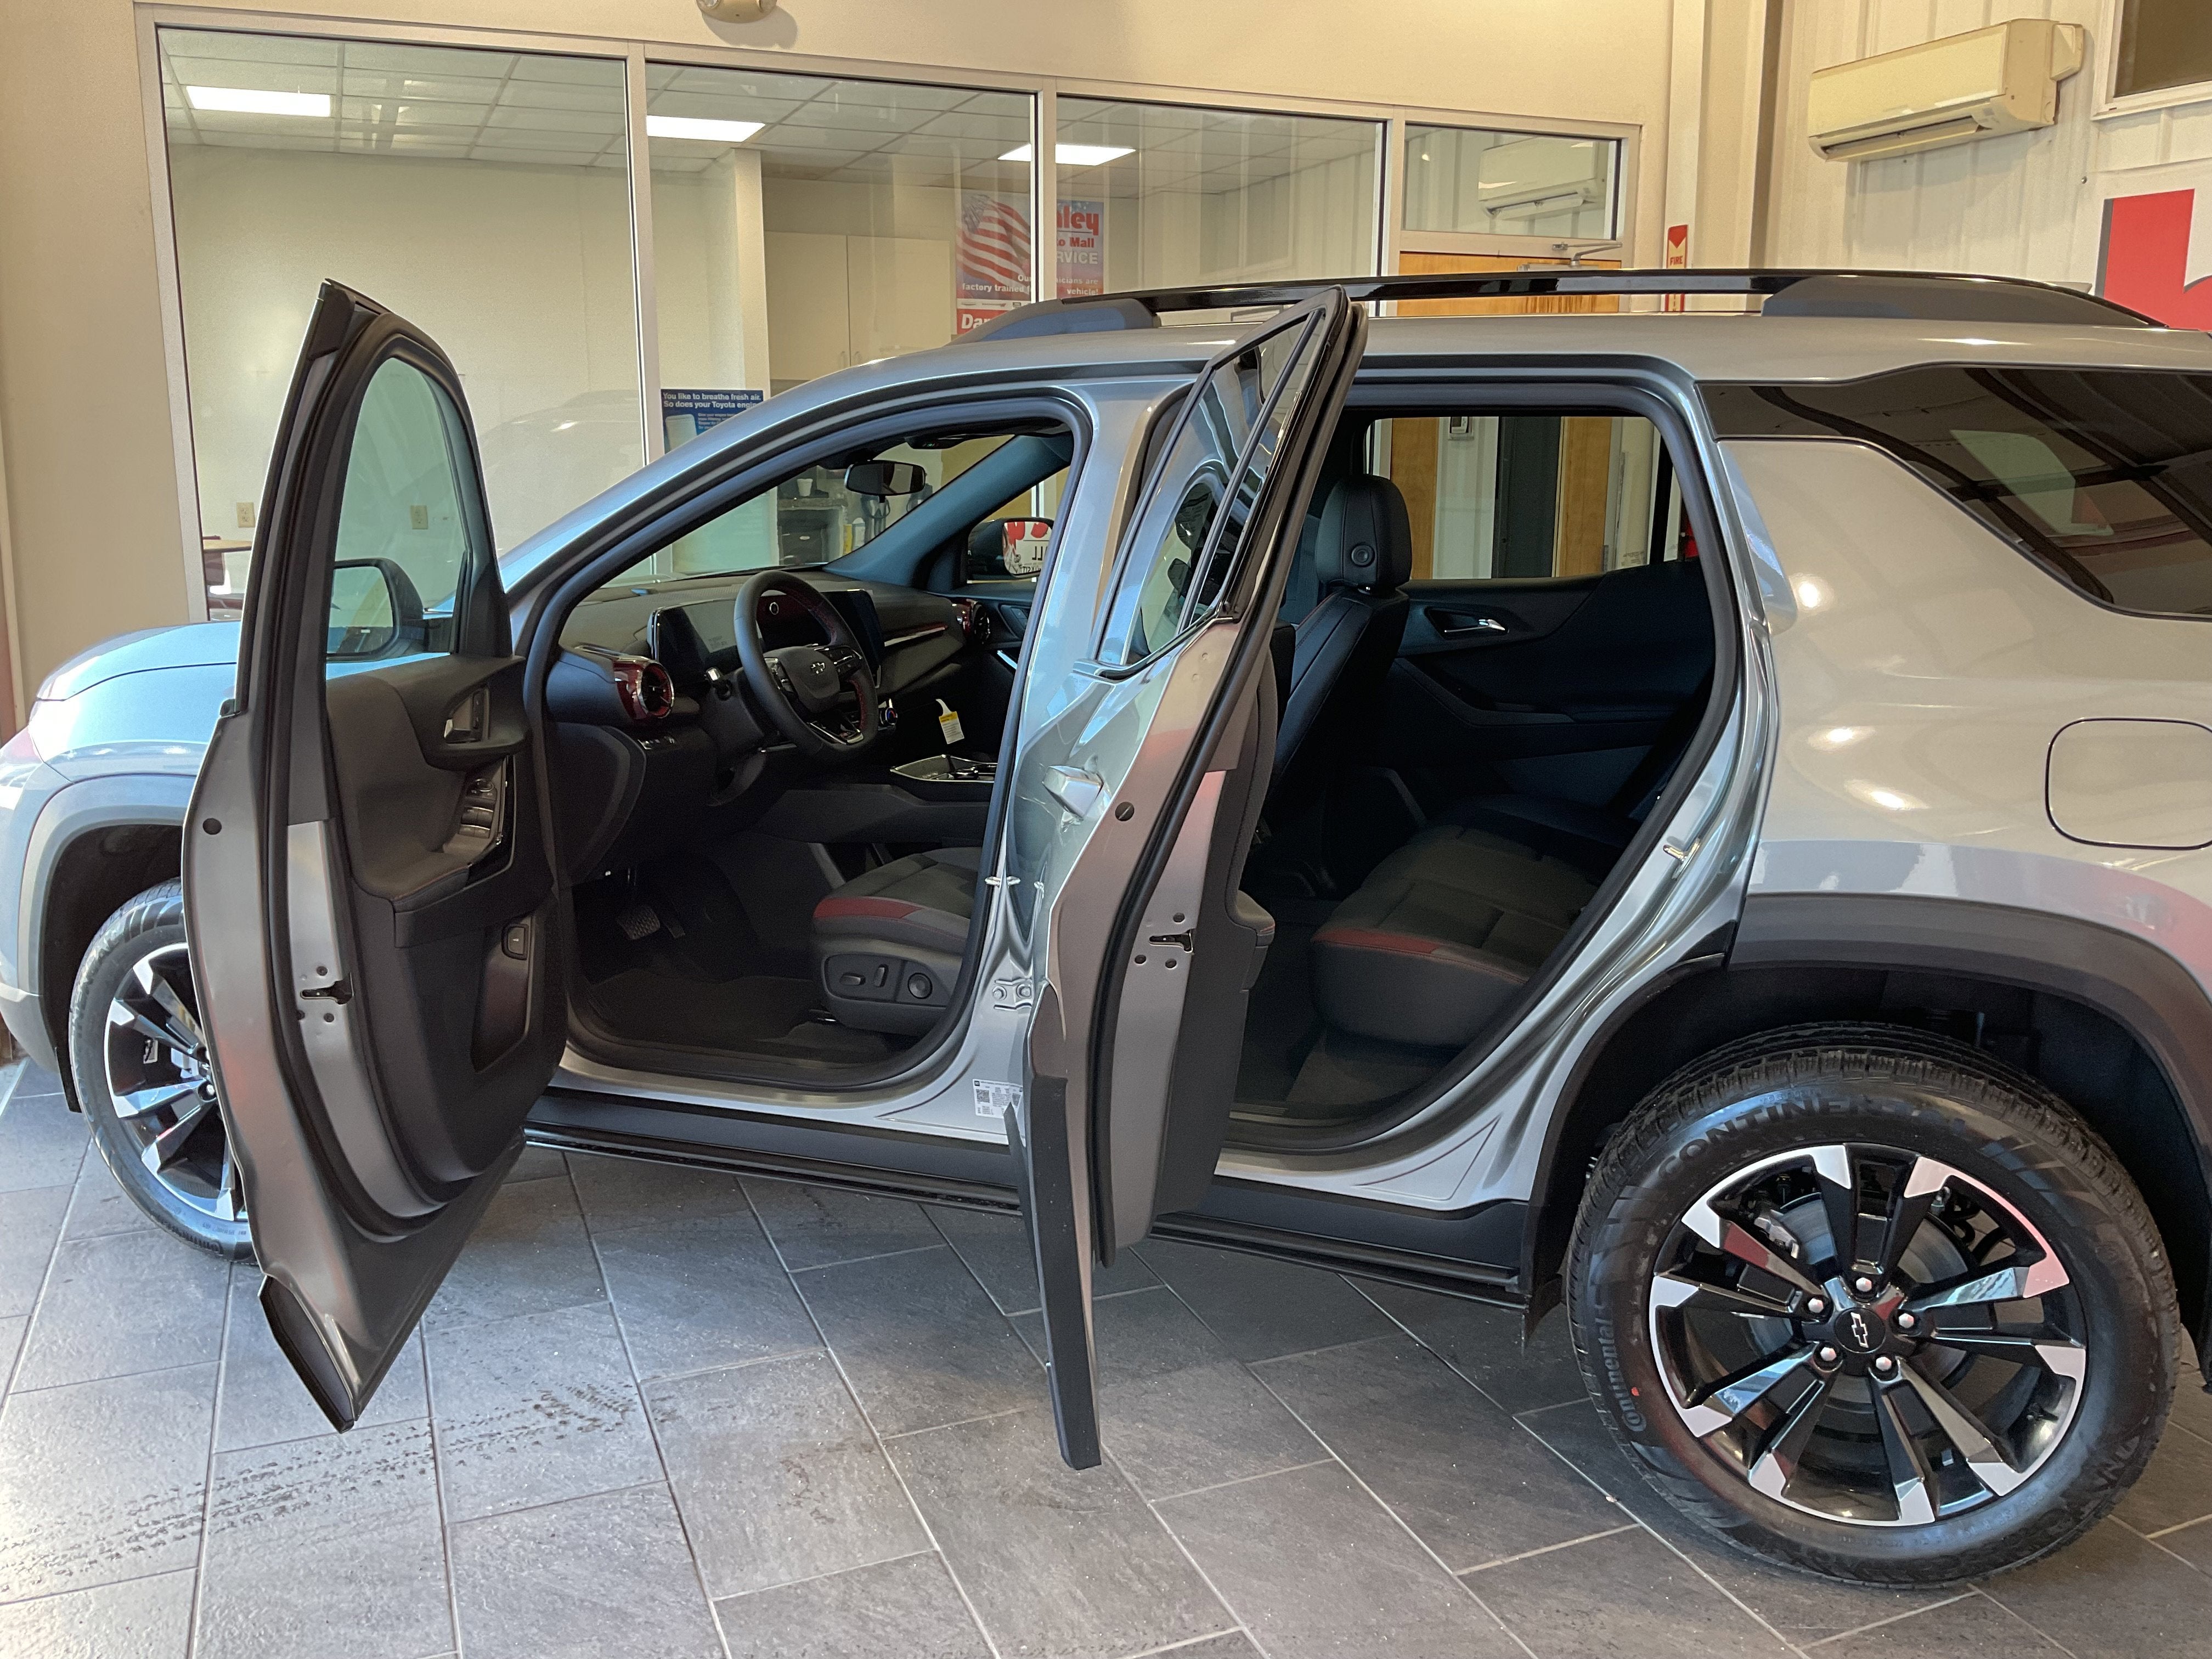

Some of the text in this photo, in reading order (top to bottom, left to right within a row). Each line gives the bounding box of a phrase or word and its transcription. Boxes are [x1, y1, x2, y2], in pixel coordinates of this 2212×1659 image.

[1069, 237, 1094, 248] Mall
[1670, 256, 1684, 266] FIRE
[962, 283, 992, 292] factory
